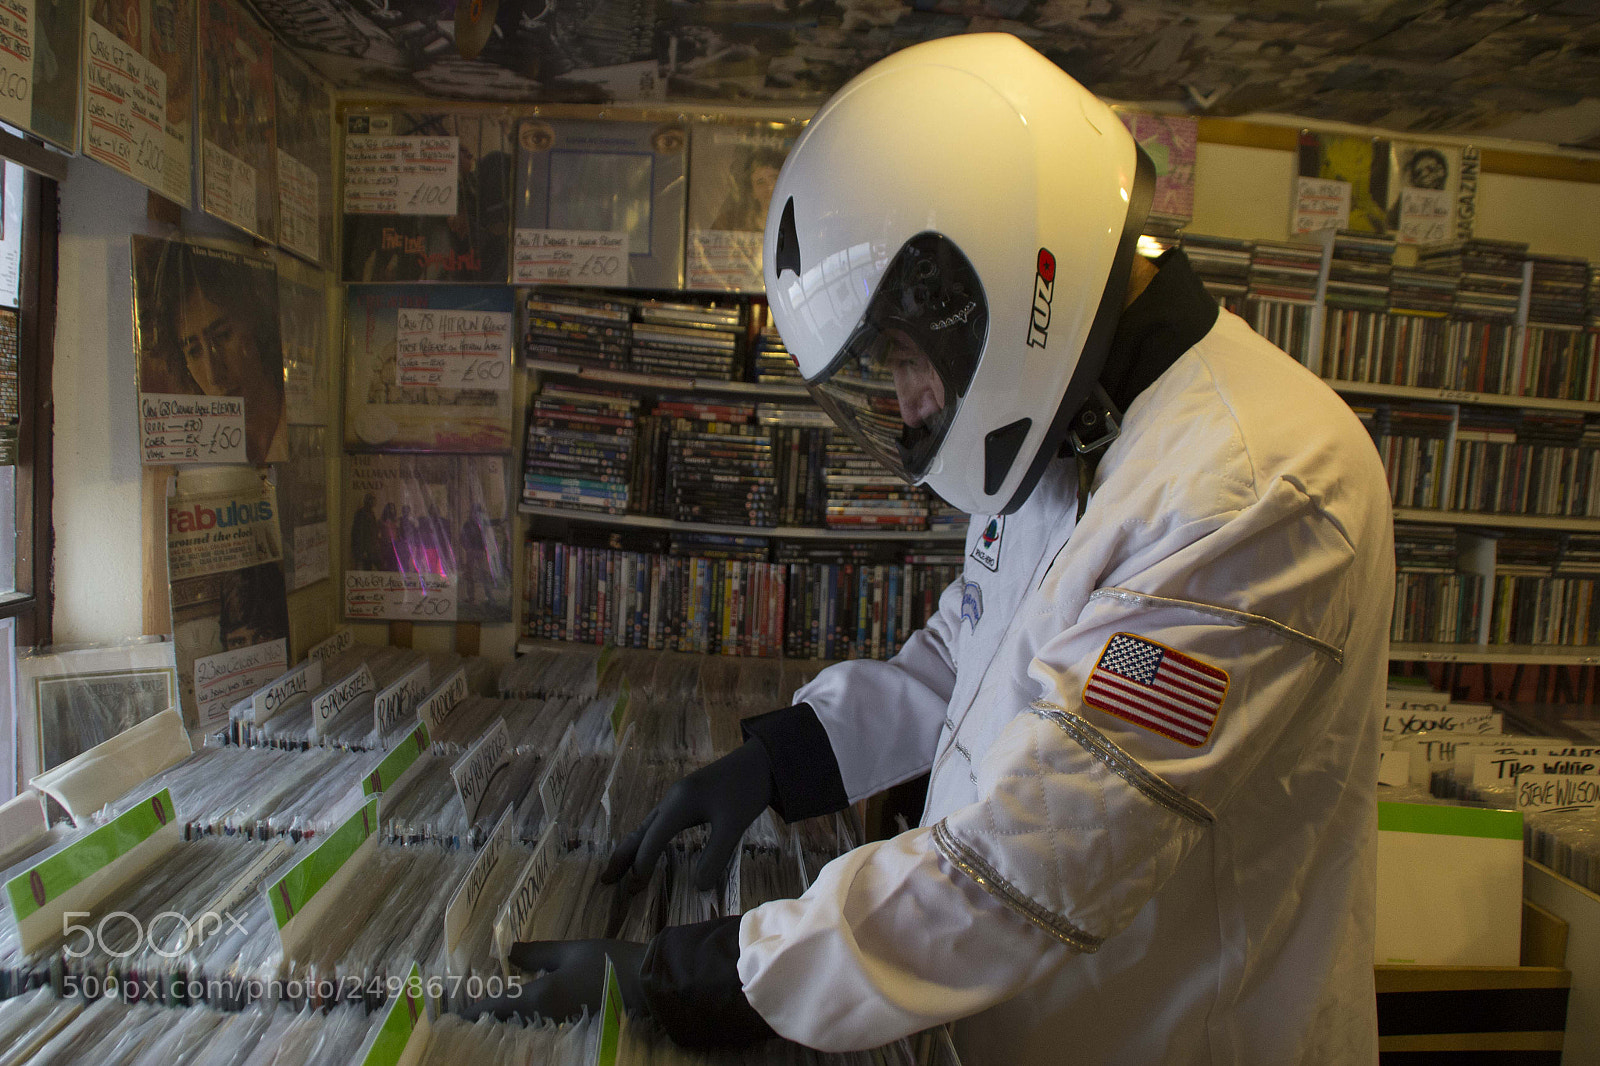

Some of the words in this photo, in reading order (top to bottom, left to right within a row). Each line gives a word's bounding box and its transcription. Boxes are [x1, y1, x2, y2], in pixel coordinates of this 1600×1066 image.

[408, 182, 452, 206] £100
[578, 254, 619, 276] £50
[462, 358, 505, 382] £60
[208, 422, 242, 454] £50
[212, 530, 230, 542] the
[264, 670, 307, 710] SANTANA
[320, 672, 373, 719] SPRINGSTEEN
[1519, 782, 1553, 807] STEVE
